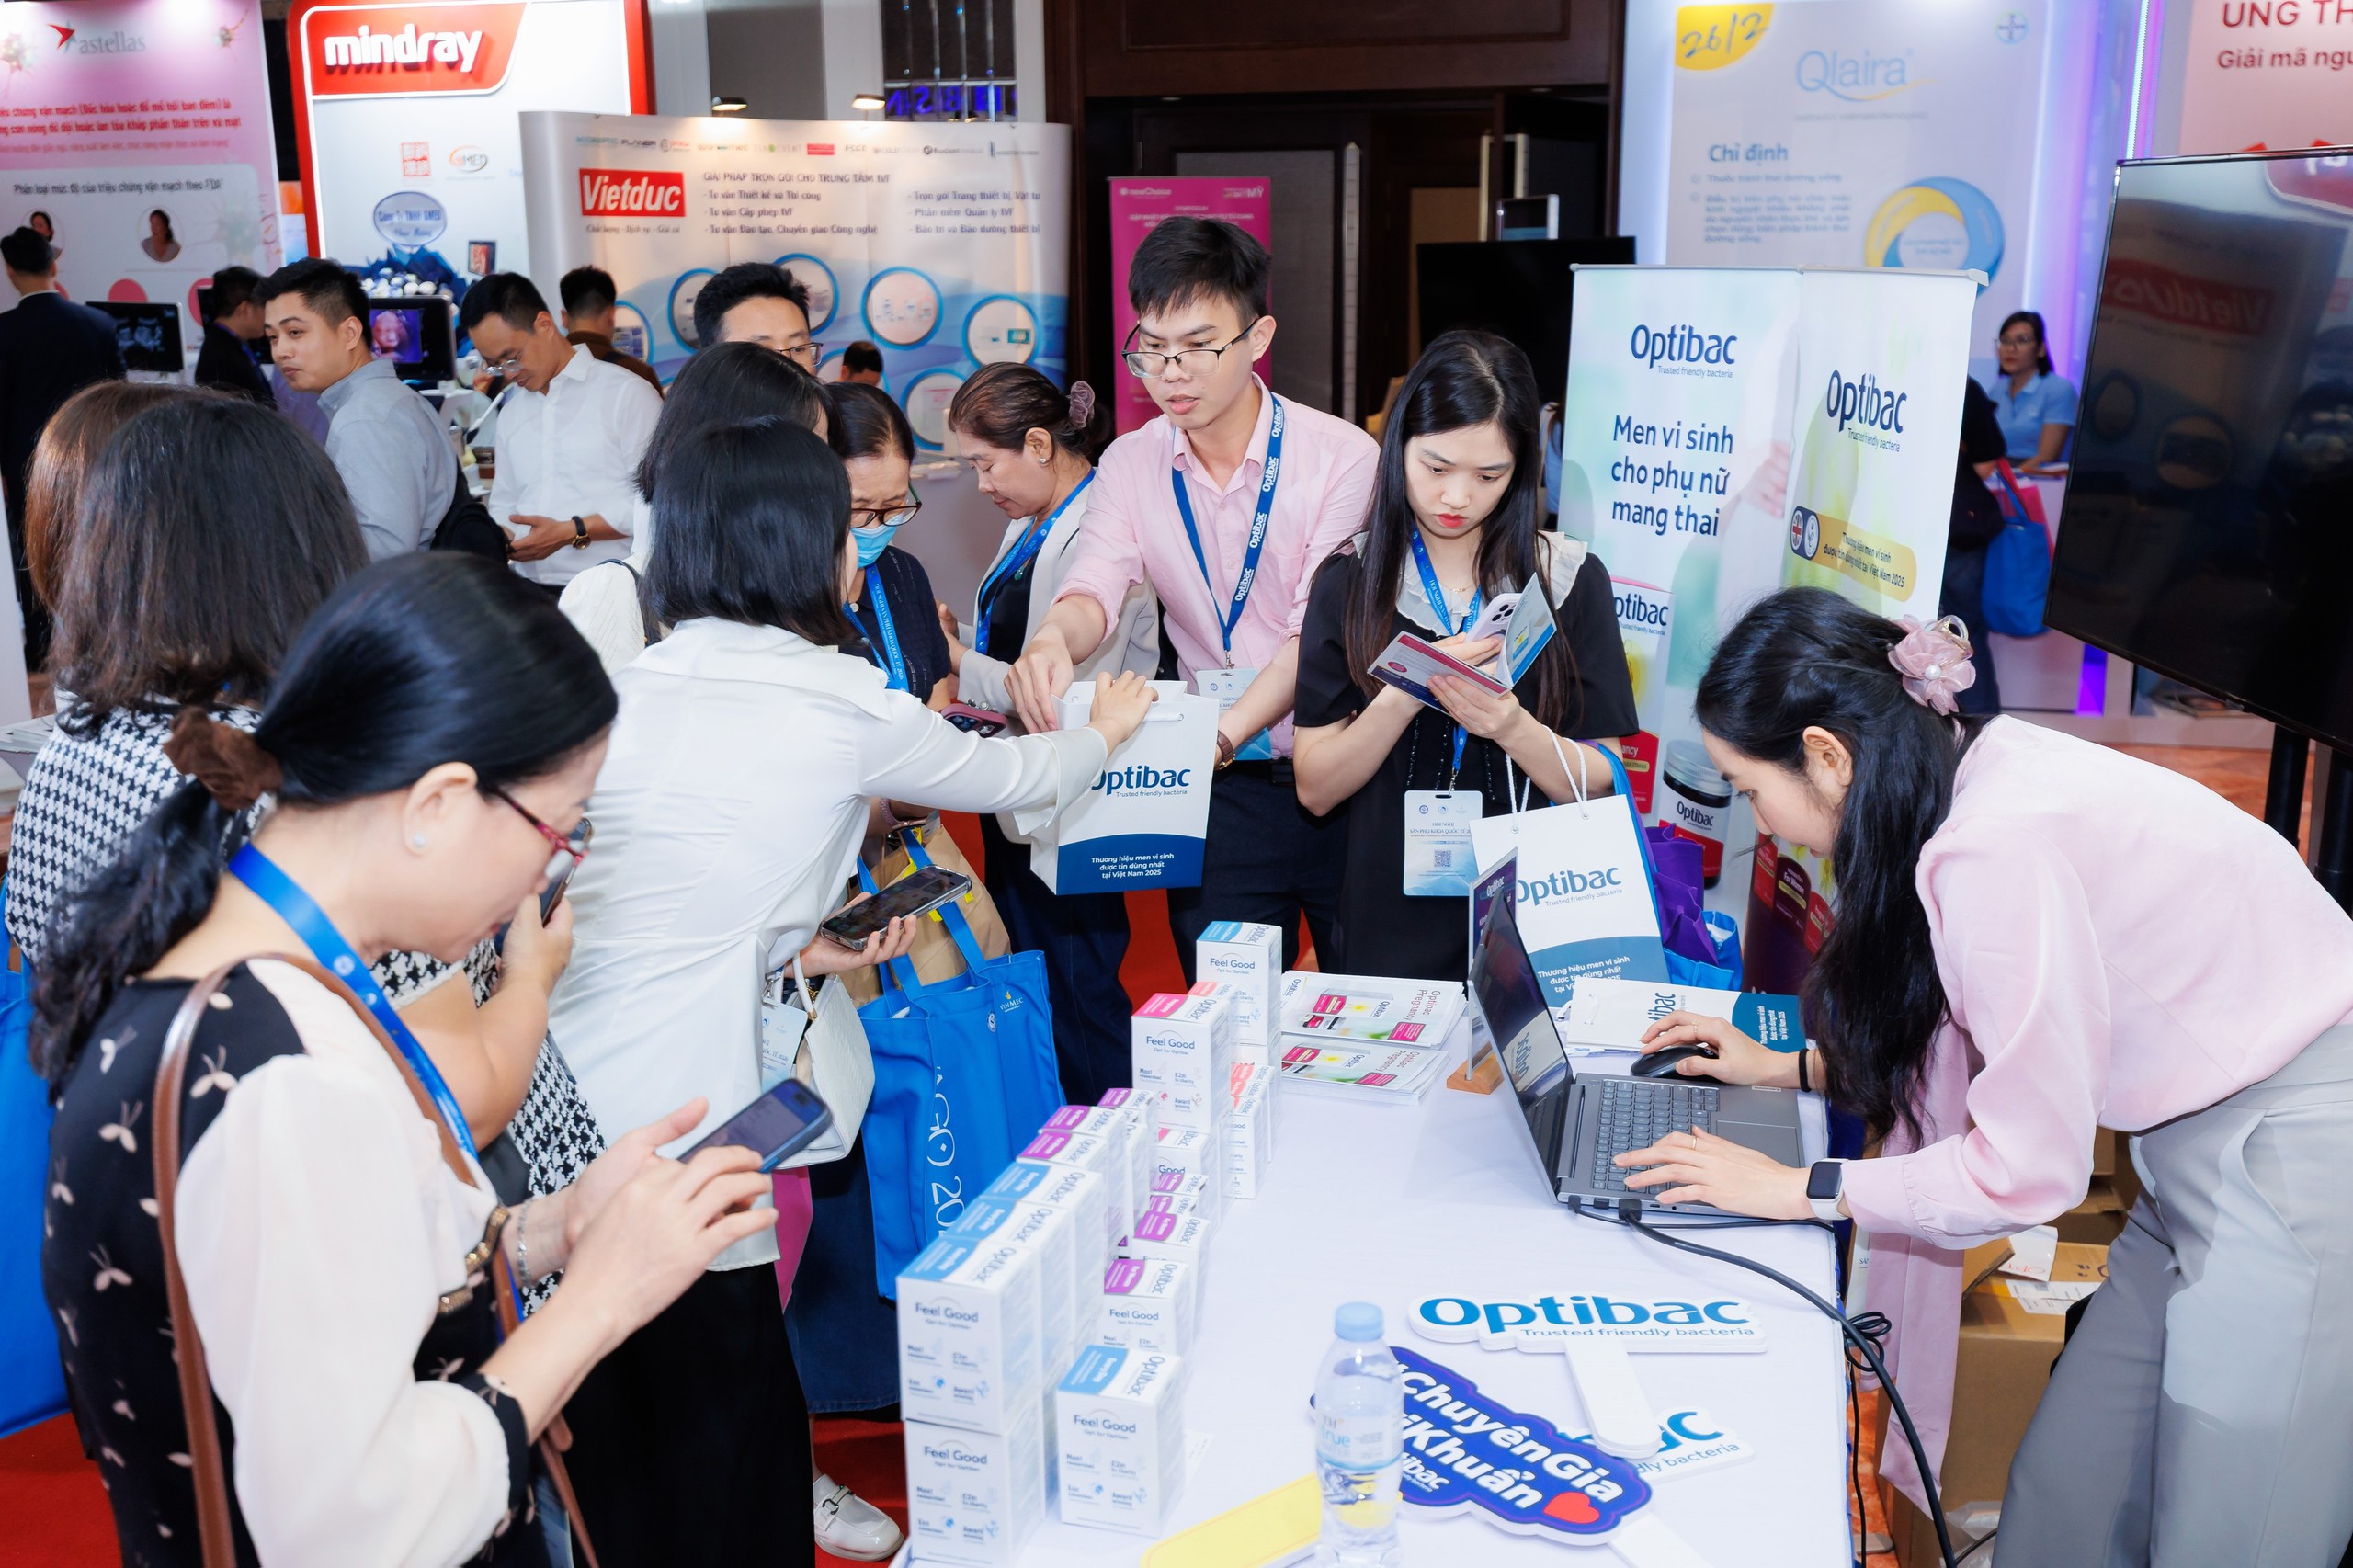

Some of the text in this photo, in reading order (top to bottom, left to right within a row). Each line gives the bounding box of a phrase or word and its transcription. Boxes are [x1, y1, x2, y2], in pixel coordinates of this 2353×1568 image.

[79, 30, 147, 55] astellas
[324, 23, 483, 73] mindray
[1681, 12, 1768, 59] 26/2
[2217, 48, 2264, 69] Giải
[2269, 47, 2307, 67] mã
[1708, 142, 1789, 166] Chỉ định
[582, 174, 682, 212] Vietduc
[952, 191, 977, 201] Trang
[1631, 324, 1738, 369] Optibac
[1657, 365, 1733, 379] Trusted friendly bacteria
[1826, 369, 1908, 434] Optibac
[1271, 404, 1283, 437] Optibac
[1613, 415, 1734, 455] Men vi sinh
[1262, 456, 1278, 493] Optibac
[1611, 456, 1732, 498] cho phụ nữ
[1249, 511, 1266, 549] Optibac
[1611, 499, 1720, 537] mang thai
[1234, 568, 1254, 602] Optibac
[1891, 573, 1905, 588] 2025
[1613, 592, 1669, 627] ptibac
[1139, 790, 1162, 798] friendly
[1163, 789, 1188, 797] bacteria
[1677, 801, 1714, 826] Optibac
[1091, 855, 1118, 864] Thương
[1119, 854, 1135, 862] hiệu
[1159, 852, 1175, 860] sinh
[1099, 862, 1118, 871] được
[1129, 861, 1148, 870] dùng
[1148, 859, 1165, 869] nhất
[1111, 869, 1127, 879] Việt
[1127, 869, 1144, 878] Nam
[1145, 869, 1162, 877] 2025
[1545, 888, 1623, 907] Trusted friendly bacteria
[1210, 958, 1256, 970] Feel Good
[1538, 955, 1631, 980] Thương hiệu men vi sinh
[1550, 976, 1570, 986] được
[1604, 966, 1622, 976] nhất
[1554, 985, 1565, 994] tại
[1404, 989, 1428, 1021] Pregnancy
[1422, 990, 1441, 1016] Optibac
[1647, 992, 1677, 1021] tibac
[1146, 1036, 1195, 1050] Feel Good
[1153, 1264, 1177, 1294] Optibac
[915, 1302, 979, 1323] Feel Good
[1109, 1309, 1159, 1321] Feel Good
[1418, 1294, 1751, 1335] Optibac
[1521, 1325, 1755, 1339] Trusted friendly bacteria
[1127, 1356, 1165, 1397] Optibac
[1074, 1415, 1137, 1434] Feel Good
[1322, 1426, 1351, 1448] true
[1397, 1361, 1625, 1504] ChuyênGia
[924, 1445, 988, 1465] Feel Good
[1402, 1412, 1544, 1509] iKhuẩn
[1661, 1441, 1741, 1469] bacteria
[1402, 1452, 1450, 1491] tibac
